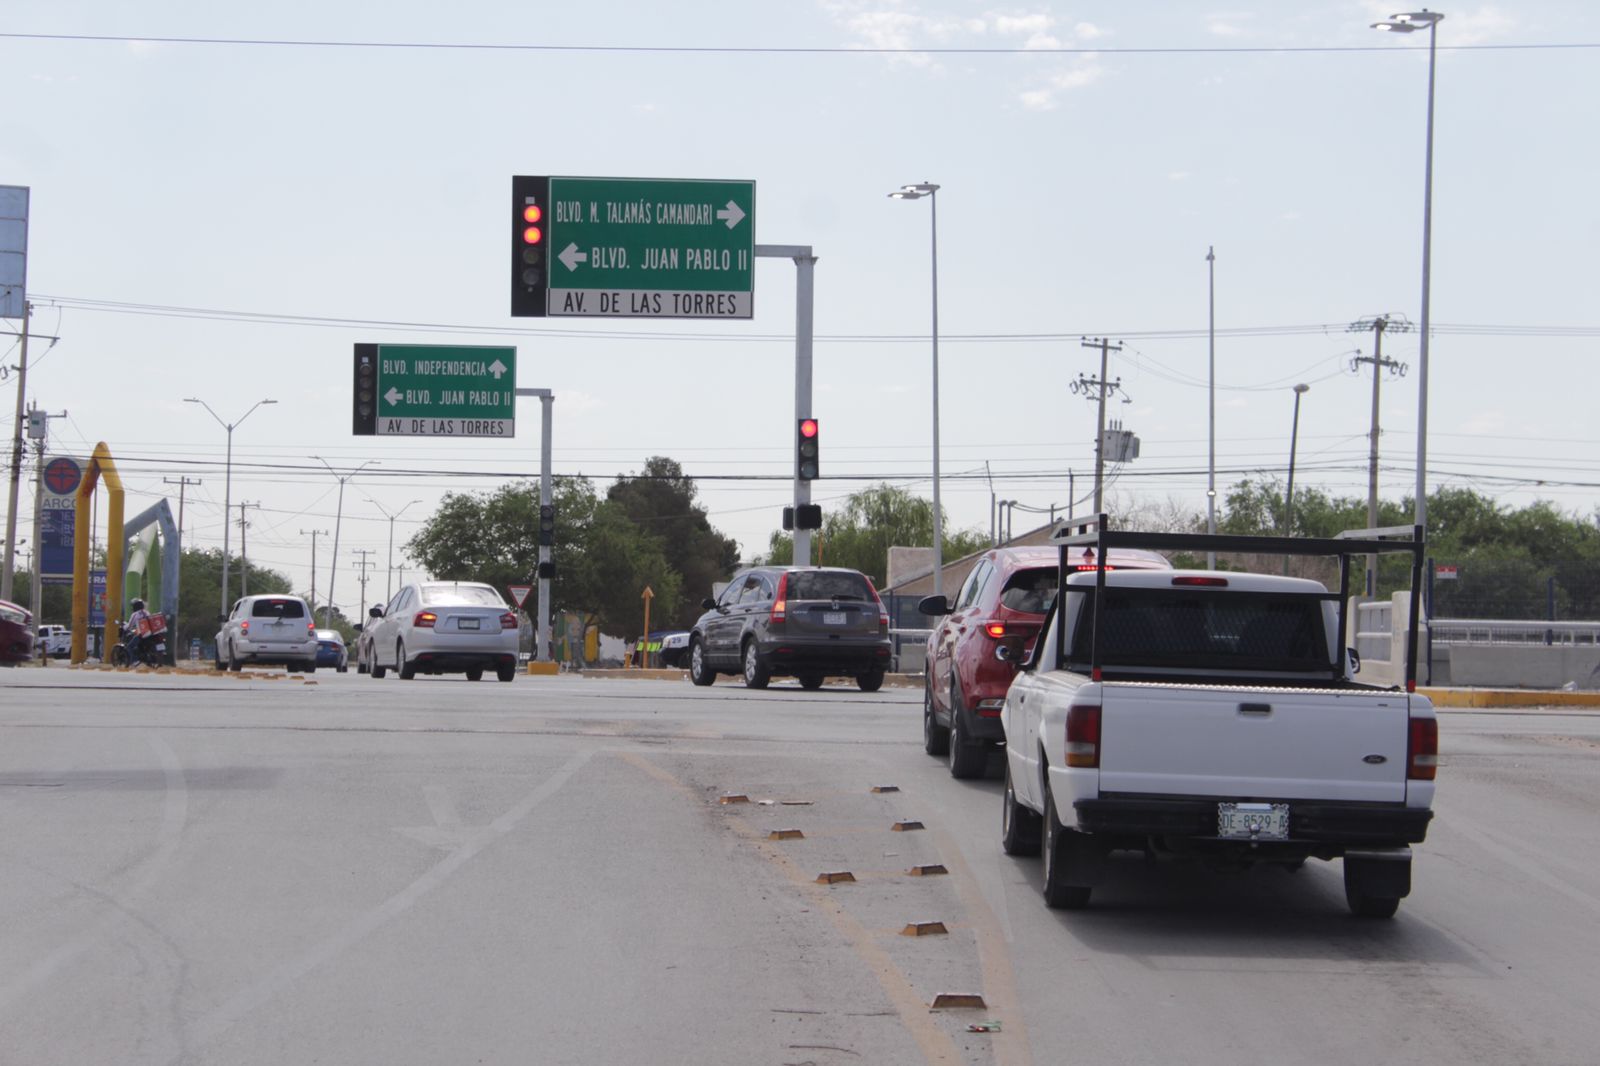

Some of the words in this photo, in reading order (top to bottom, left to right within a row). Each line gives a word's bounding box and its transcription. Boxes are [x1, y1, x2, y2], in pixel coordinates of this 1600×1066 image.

[556, 201, 583, 223] BLVD.
[590, 202, 600, 222] M.
[607, 199, 652, 224] TALAMÁS
[656, 203, 713, 225] CAMANDARI
[591, 247, 630, 269] BLVD.
[641, 249, 678, 269] JUAN
[686, 250, 730, 270] PABLO
[738, 251, 747, 270] II
[563, 292, 587, 313] AV.
[600, 293, 620, 313] DE
[631, 294, 662, 313] LAS
[673, 294, 737, 314] TORRES
[383, 360, 408, 375] BLVD.
[415, 360, 487, 376] INDEPENDENCIA
[406, 389, 432, 405] BLVD.
[439, 391, 464, 406] JUAN
[469, 392, 499, 406] PABLO
[504, 392, 511, 406] II
[387, 420, 404, 433] AV.
[412, 420, 426, 433] DE
[433, 421, 453, 434] LAS
[461, 421, 504, 435] TORRES
